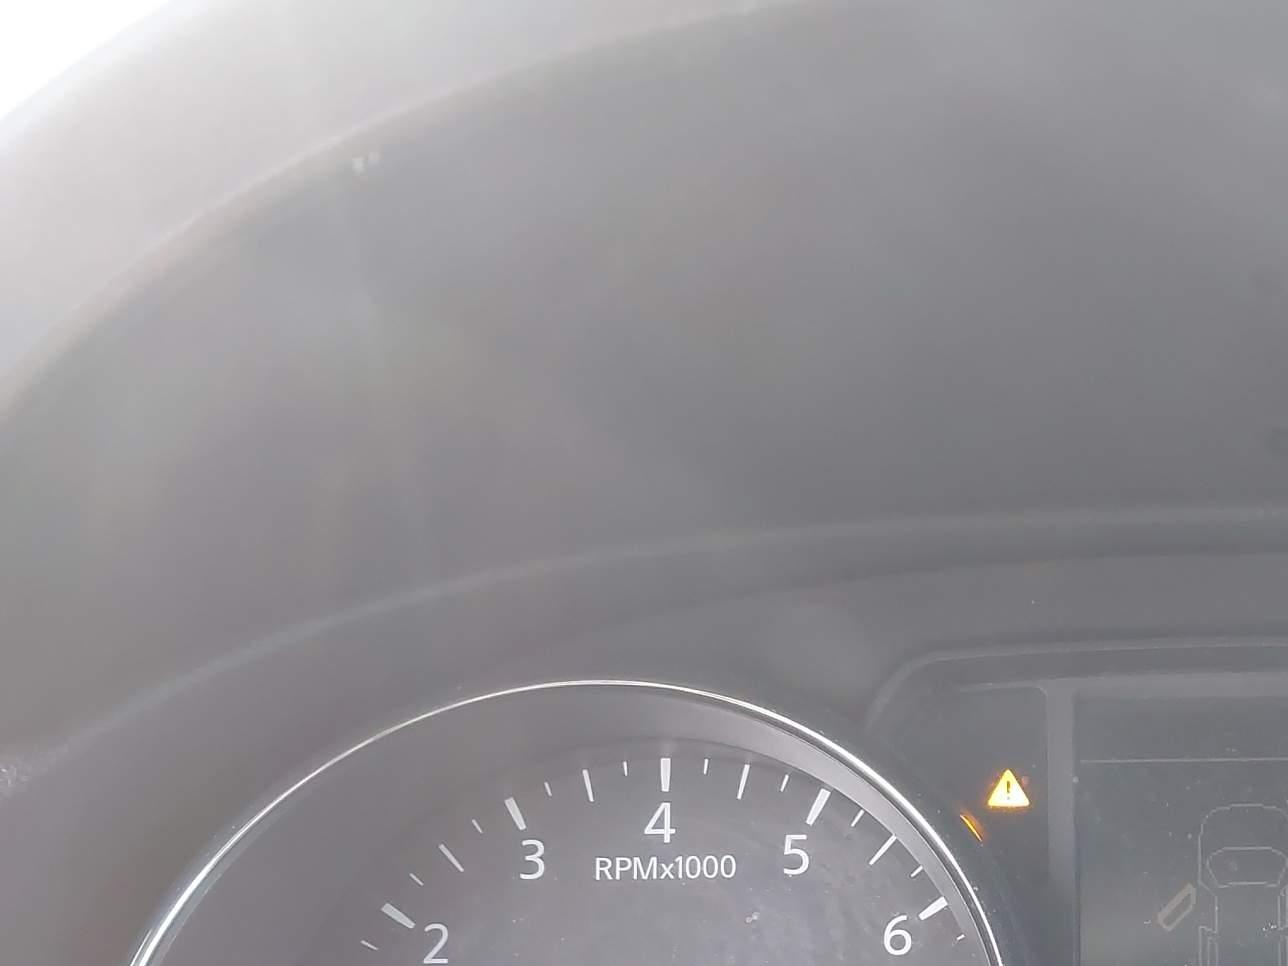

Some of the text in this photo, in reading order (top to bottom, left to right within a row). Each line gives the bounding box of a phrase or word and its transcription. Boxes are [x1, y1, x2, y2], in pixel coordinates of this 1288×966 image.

[643, 802, 677, 844] 4
[519, 839, 546, 880] 3
[595, 854, 737, 881] RPMx1000
[783, 834, 811, 875] 5
[423, 923, 450, 964] 2
[883, 914, 912, 956] 6
